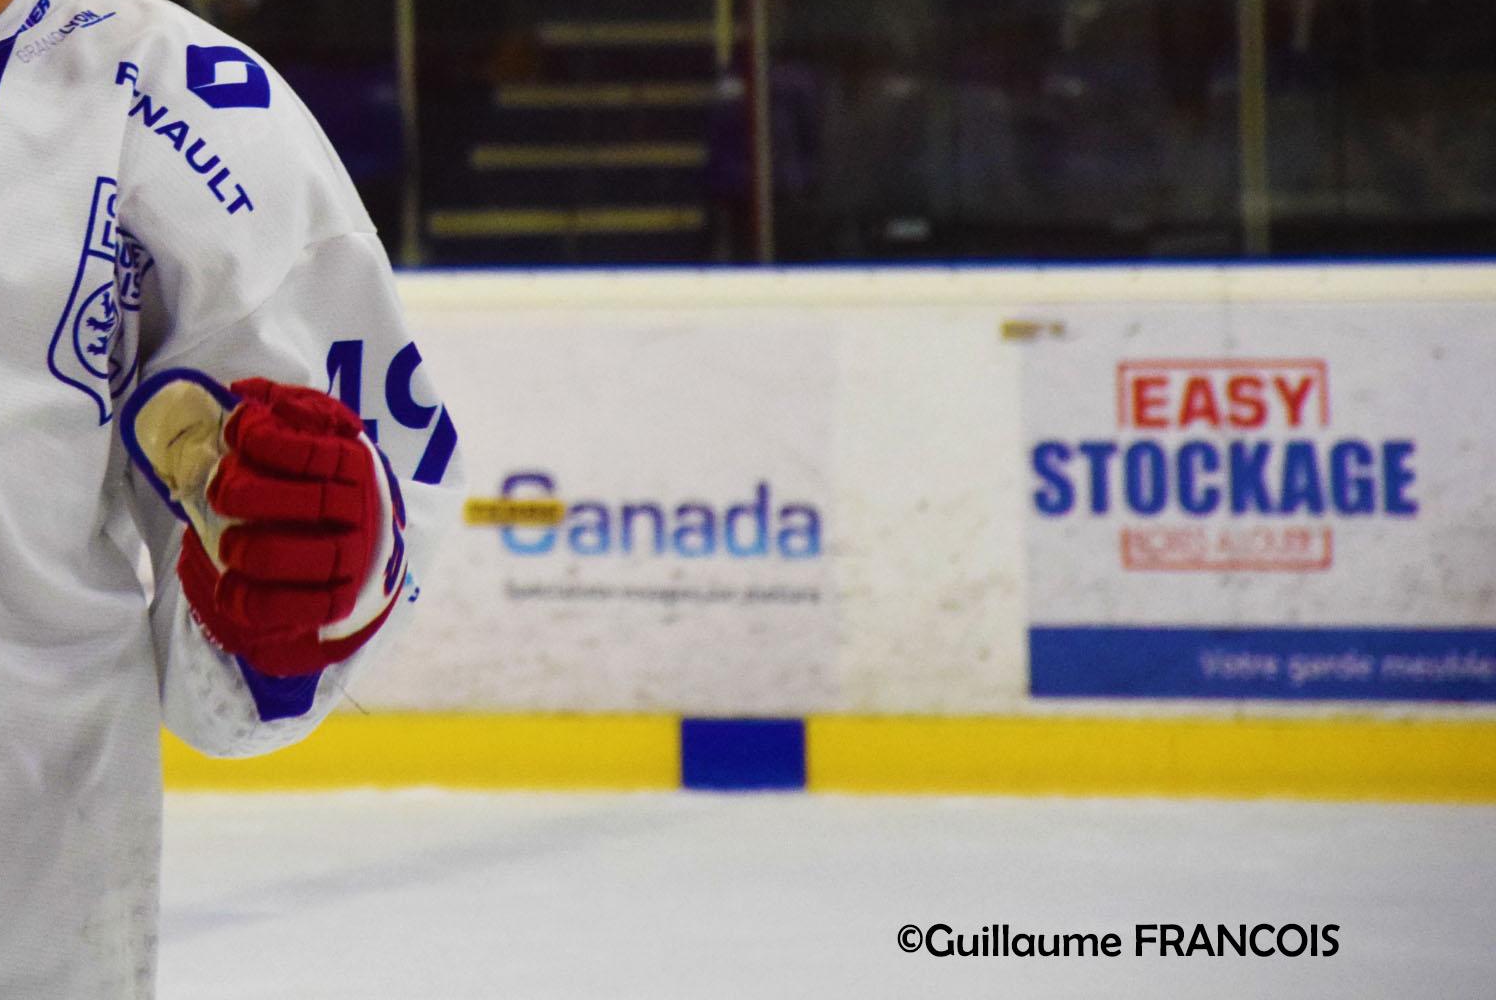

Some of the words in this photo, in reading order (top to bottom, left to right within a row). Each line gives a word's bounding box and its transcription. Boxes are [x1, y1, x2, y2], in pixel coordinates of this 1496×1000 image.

[115, 61, 255, 216] RNAULT
[1130, 374, 1315, 430] EASY
[496, 470, 824, 560] Canada
[1030, 437, 1421, 519] STOCKAGE
